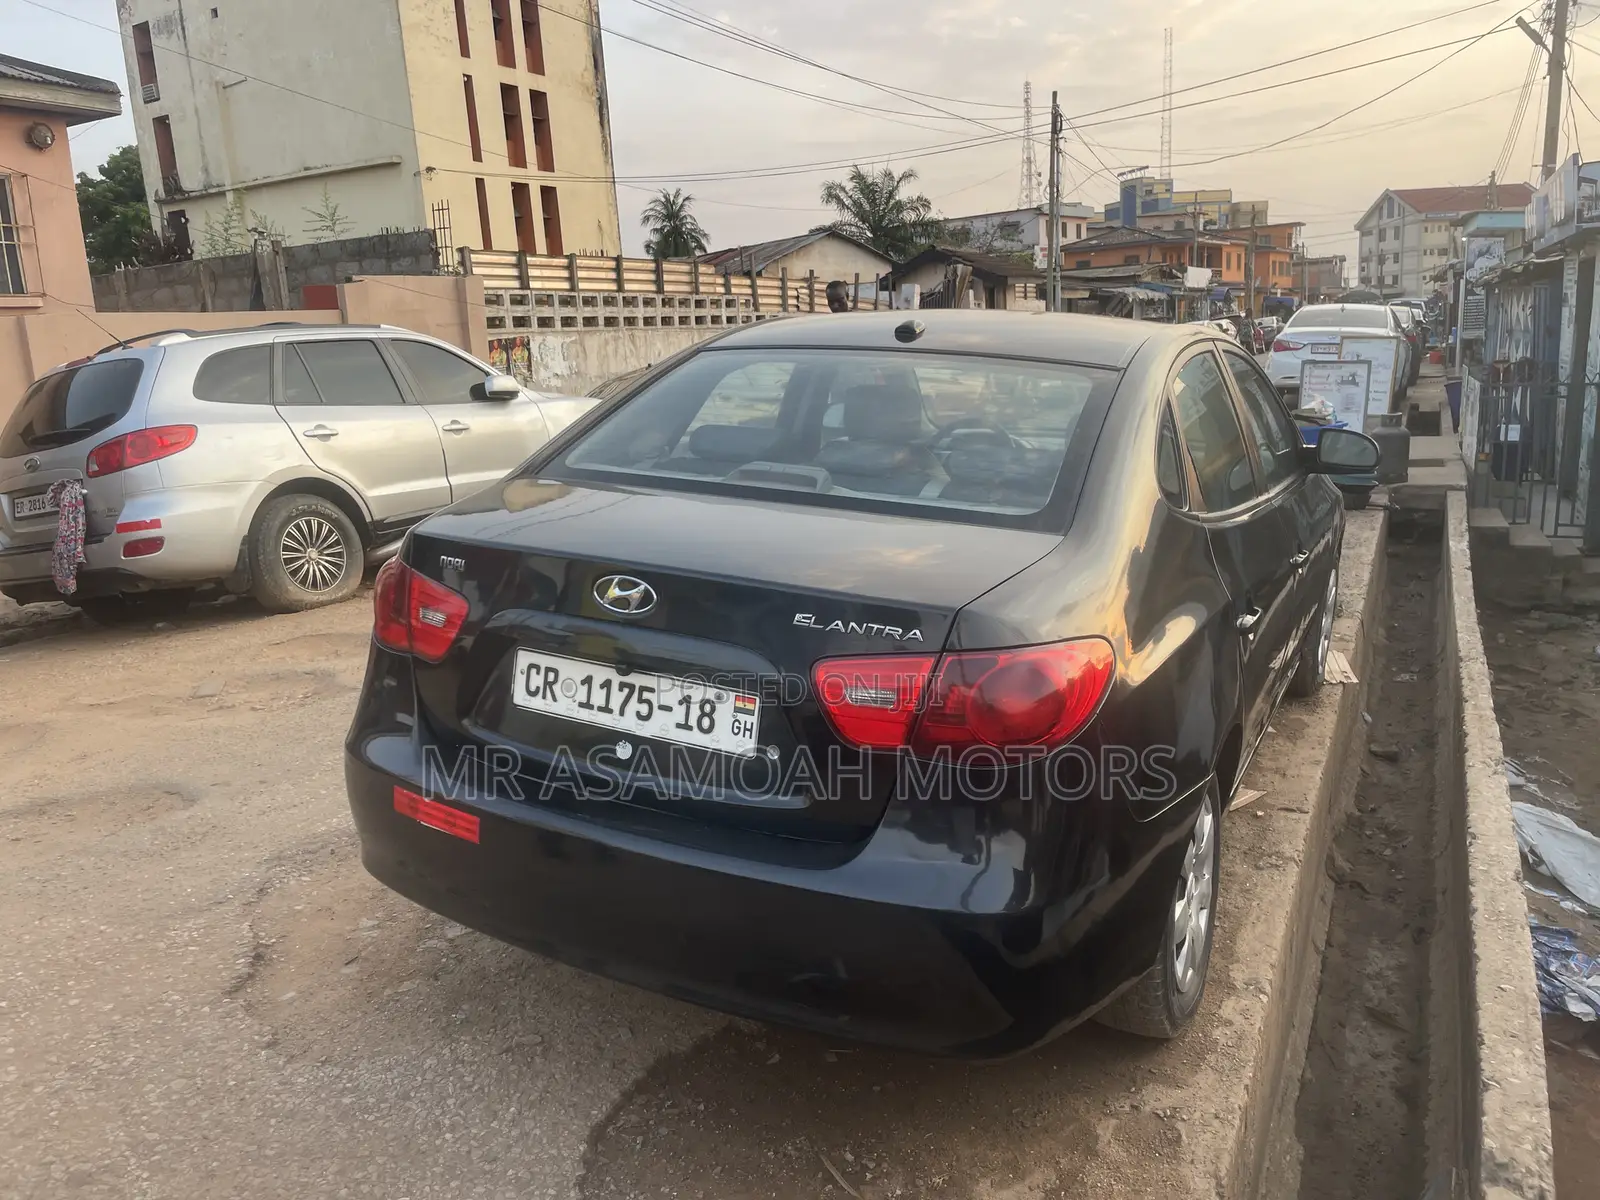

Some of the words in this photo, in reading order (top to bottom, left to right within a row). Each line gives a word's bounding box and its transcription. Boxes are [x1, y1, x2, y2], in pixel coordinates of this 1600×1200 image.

[16, 501, 25, 514] ER
[28, 498, 46, 512] 2816
[793, 613, 924, 642] ELANTRA
[525, 663, 560, 703] CR
[578, 674, 717, 735] 1175-18
[731, 718, 754, 739] GH
